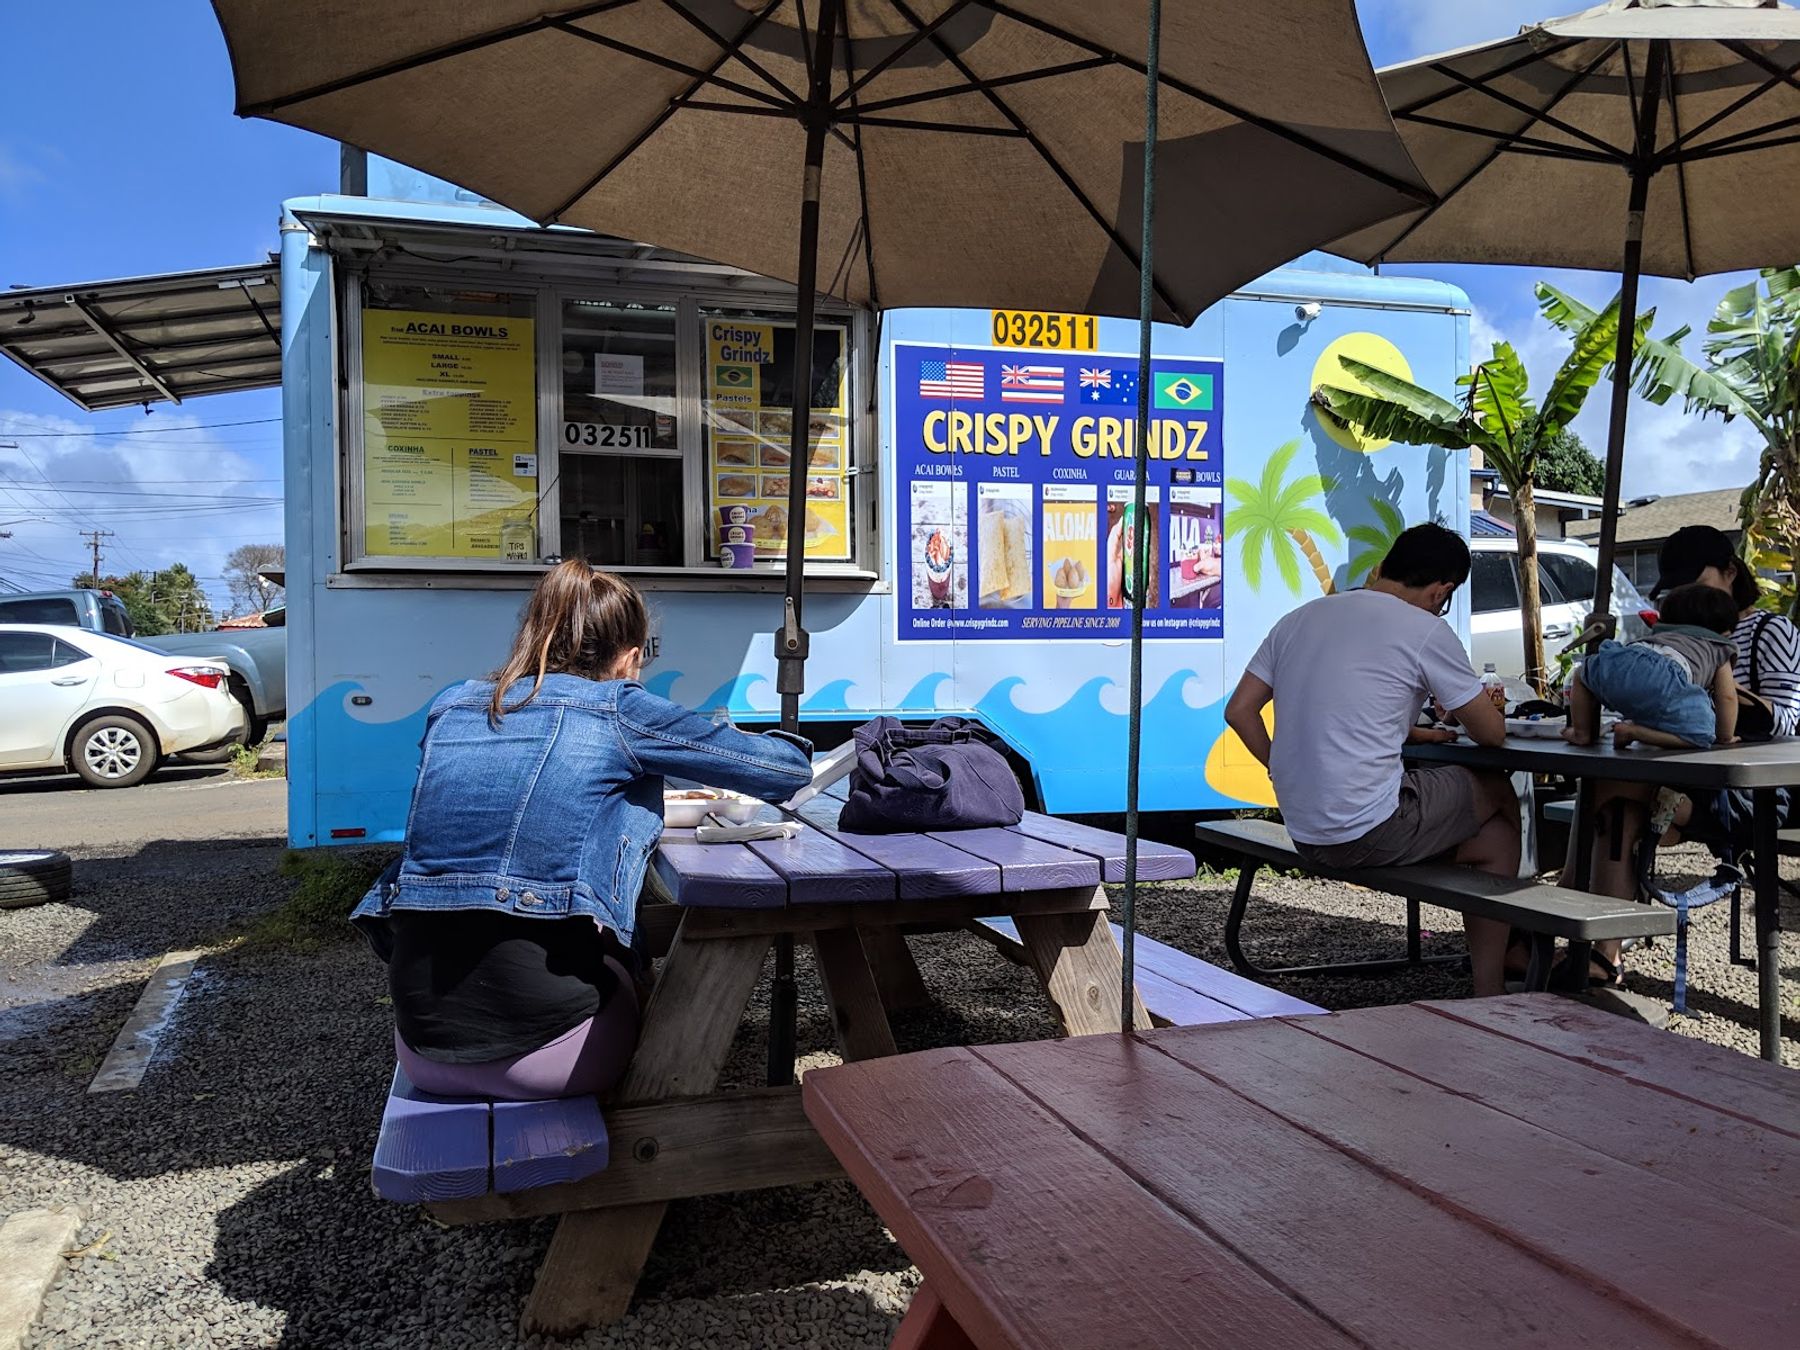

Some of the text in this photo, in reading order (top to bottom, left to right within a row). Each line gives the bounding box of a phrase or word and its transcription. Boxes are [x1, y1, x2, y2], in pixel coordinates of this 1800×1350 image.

[406, 322, 445, 335] ACAI
[451, 325, 509, 339] BOWLS
[712, 325, 762, 347] Crispy
[993, 312, 1095, 349] 032511
[432, 353, 460, 361] SMALL
[721, 345, 770, 364] Grindz
[431, 362, 459, 370] LARGE
[716, 394, 753, 402] Pastels
[565, 423, 650, 449] 032511
[922, 410, 1209, 460] CRISPY GRINDZ
[388, 445, 425, 453] COXINHA
[469, 448, 498, 456] PASTEL
[914, 464, 963, 476] ACAI BOWLS
[992, 466, 1020, 478] PASTEL
[1052, 468, 1087, 480] COXINHA
[1195, 472, 1221, 483] BOWLS
[1043, 511, 1097, 542] ALOHA
[912, 618, 930, 628] Online
[931, 618, 946, 628] Order
[1021, 617, 1052, 629] SERVING
[1053, 617, 1083, 629] PIPELINE
[1084, 617, 1104, 628] SINCE
[1157, 619, 1163, 627] on
[1164, 617, 1188, 629] Instagram
